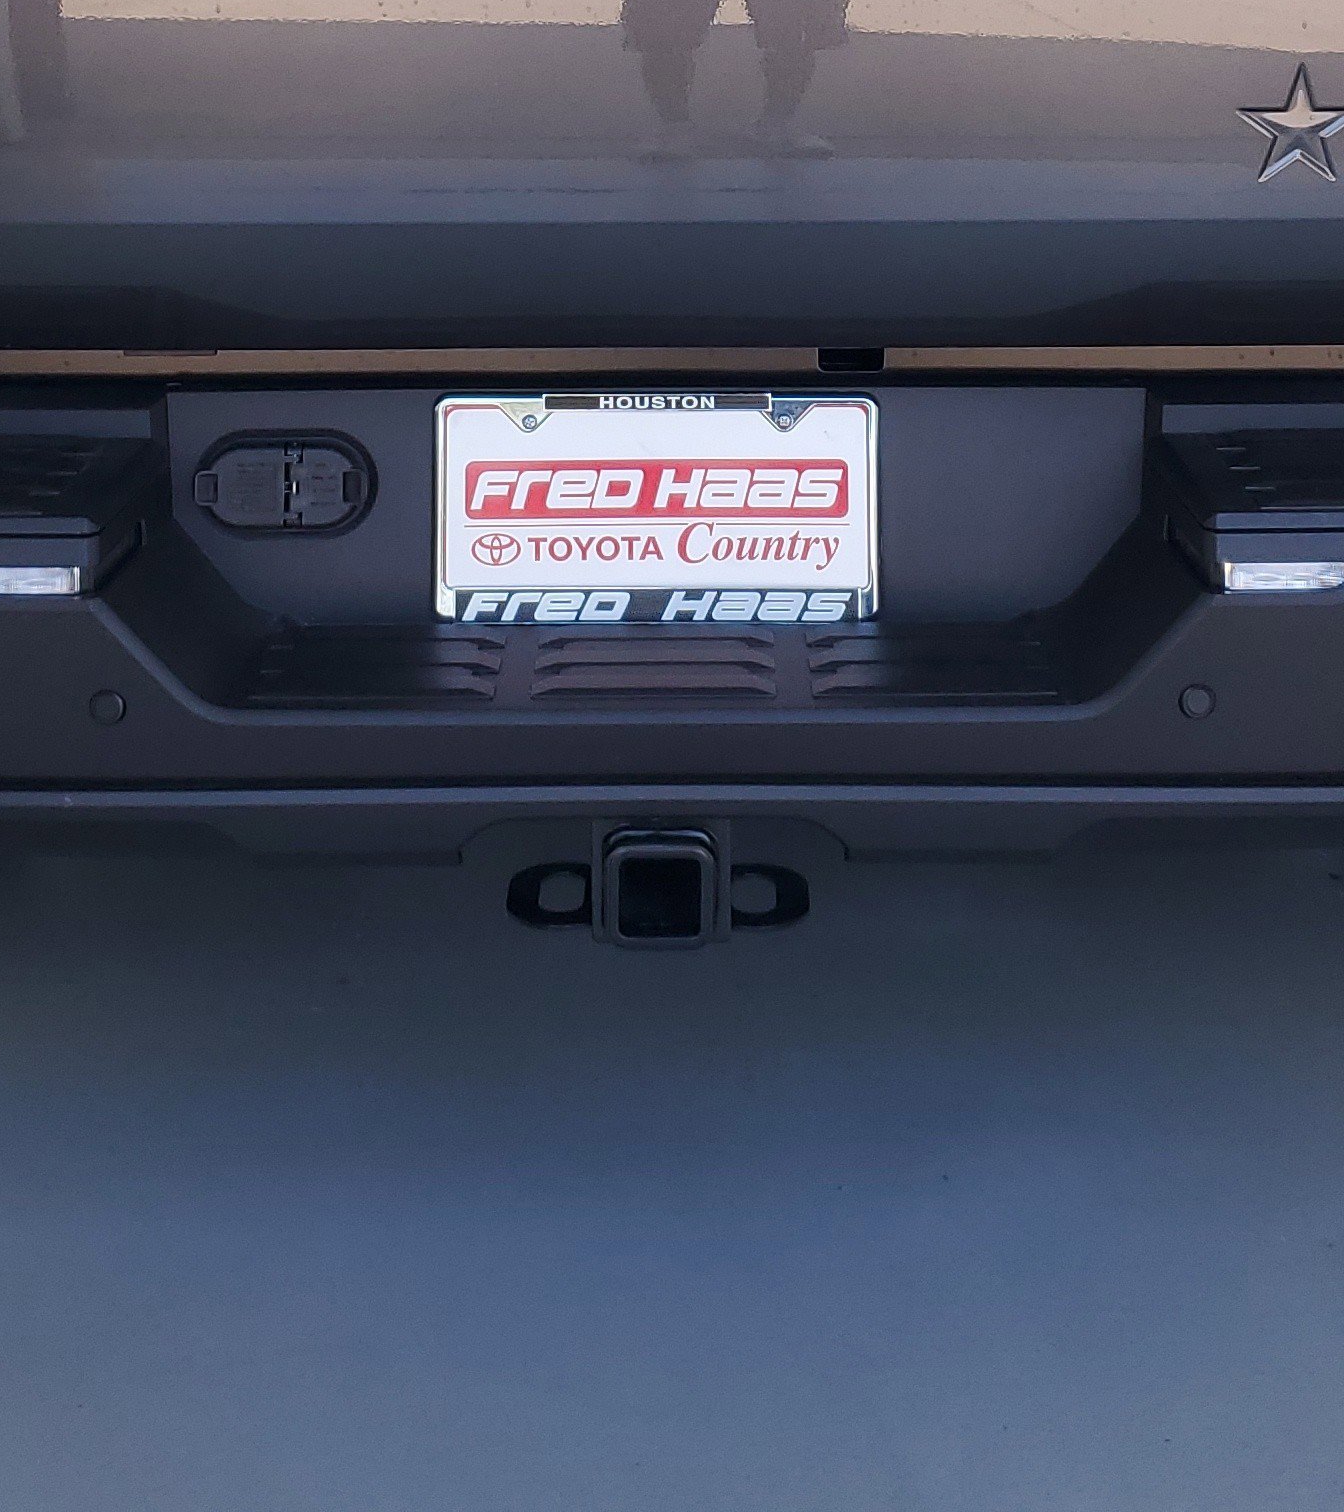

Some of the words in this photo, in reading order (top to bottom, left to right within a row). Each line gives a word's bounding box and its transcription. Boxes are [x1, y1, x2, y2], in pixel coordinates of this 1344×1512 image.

[599, 396, 715, 409] HOUSTON
[528, 536, 664, 561] TOYOTA
[677, 521, 840, 570] Country
